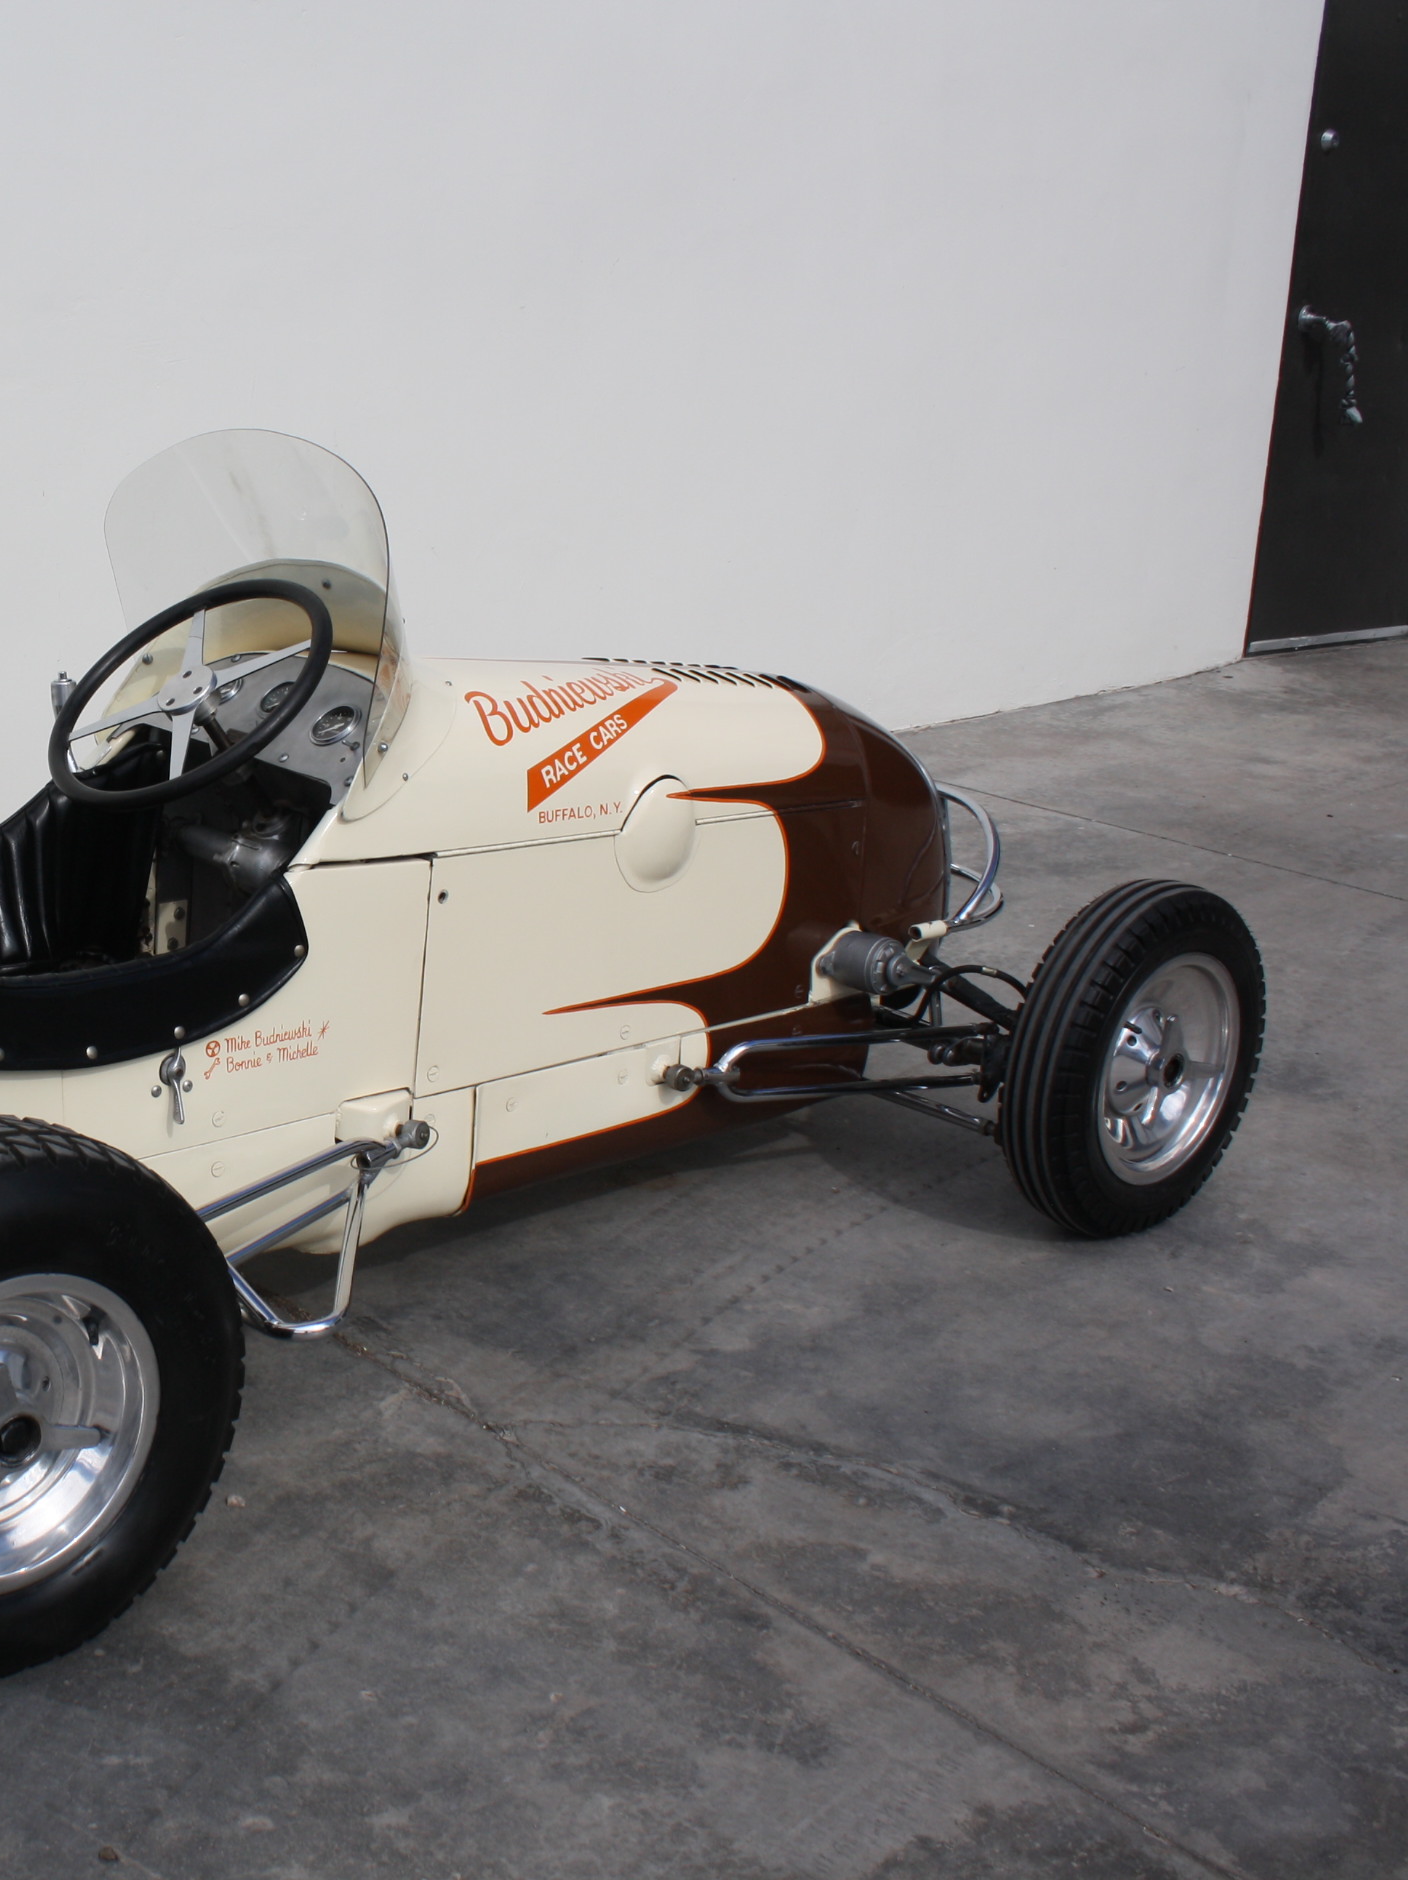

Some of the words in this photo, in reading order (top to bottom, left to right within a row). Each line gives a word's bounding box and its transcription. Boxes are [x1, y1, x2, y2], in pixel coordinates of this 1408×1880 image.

[464, 666, 652, 746] Budniewski
[540, 743, 588, 788] RACE
[589, 714, 628, 750] CARS
[538, 805, 596, 824] BUFFALO,
[224, 1035, 251, 1054] Mike
[254, 1019, 312, 1048] Budniewski
[226, 1051, 262, 1073] Bonnie
[266, 1052, 273, 1064] &
[277, 1041, 319, 1063] Michelle
